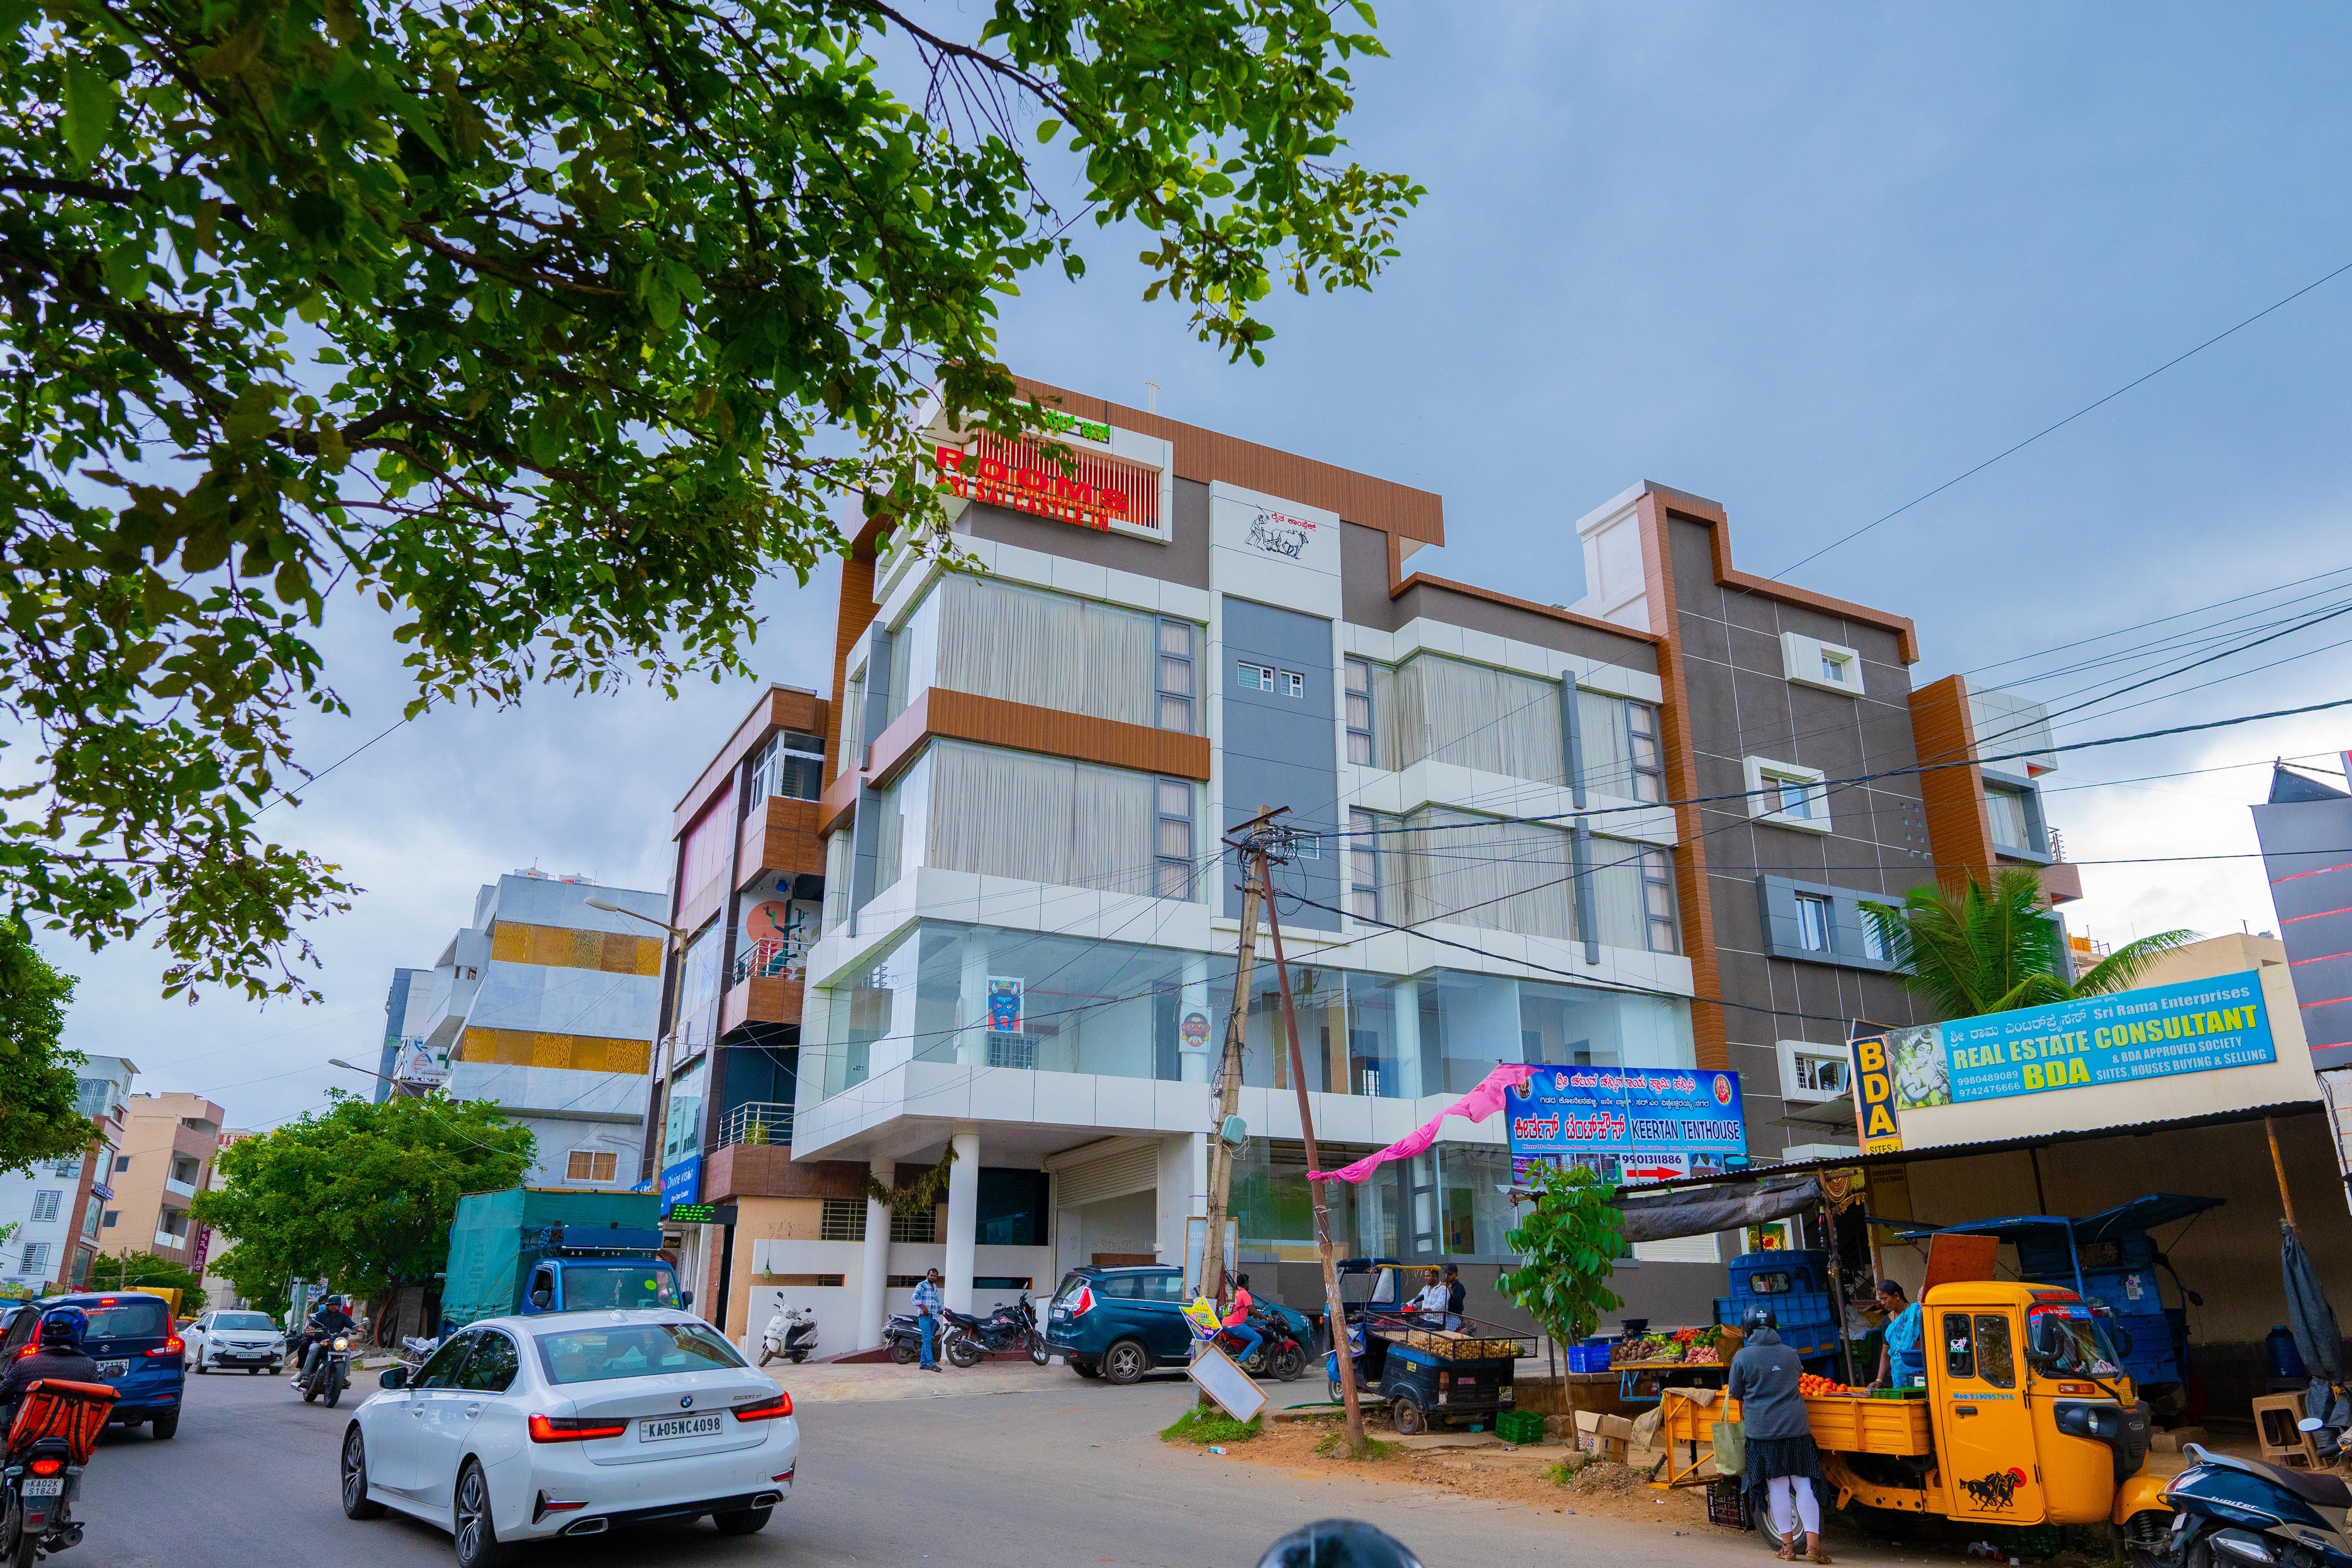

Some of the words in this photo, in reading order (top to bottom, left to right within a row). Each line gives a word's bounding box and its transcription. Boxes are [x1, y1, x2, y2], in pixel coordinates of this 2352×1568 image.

[1081, 422, 1111, 441] ಇನ್
[936, 446, 1127, 512] ROOMS
[975, 481, 1006, 507] SAI
[1013, 491, 1085, 526] CASTLE
[1091, 510, 1110, 532] IN
[1271, 513, 1285, 523] ರೈತ
[2093, 1006, 2113, 1020] Sri
[2116, 998, 2158, 1015] Rama
[2161, 986, 2251, 1010] Enterprises
[1950, 1030, 1964, 1046] ಶ್ರೀ
[1970, 1025, 1999, 1039] ರಾಮ
[1953, 1043, 2006, 1070] REAL
[2009, 1030, 2091, 1062] ESTATE
[2094, 1005, 2257, 1049] CONSULTANT
[2112, 1054, 2119, 1064] &
[2122, 1051, 2142, 1063] BDA
[2144, 1042, 2196, 1059] APPROVED
[2198, 1036, 2242, 1051] SOCIETY
[2131, 1061, 2171, 1076] HOUSES
[2173, 1056, 2212, 1071] BUYING
[2215, 1055, 2222, 1065] &
[2224, 1049, 2267, 1064] SELLING
[1556, 1074, 1569, 1090] ಶ್ರೀ
[1957, 1070, 2018, 1086] 9980489089
[2022, 1057, 2091, 1090] BDA
[1858, 1042, 1896, 1135] BDA
[1959, 1082, 2020, 1097] 9742476666
[1631, 1120, 1678, 1140] KEERTAN
[1680, 1120, 1740, 1140] TENTHOUSE
[1622, 1155, 1682, 1164] 9901311886
[1870, 1145, 1892, 1153] SITES
[667, 1172, 681, 1189] Divine
[681, 1167, 694, 1182] vision
[649, 1417, 720, 1437] KA05NC4098
